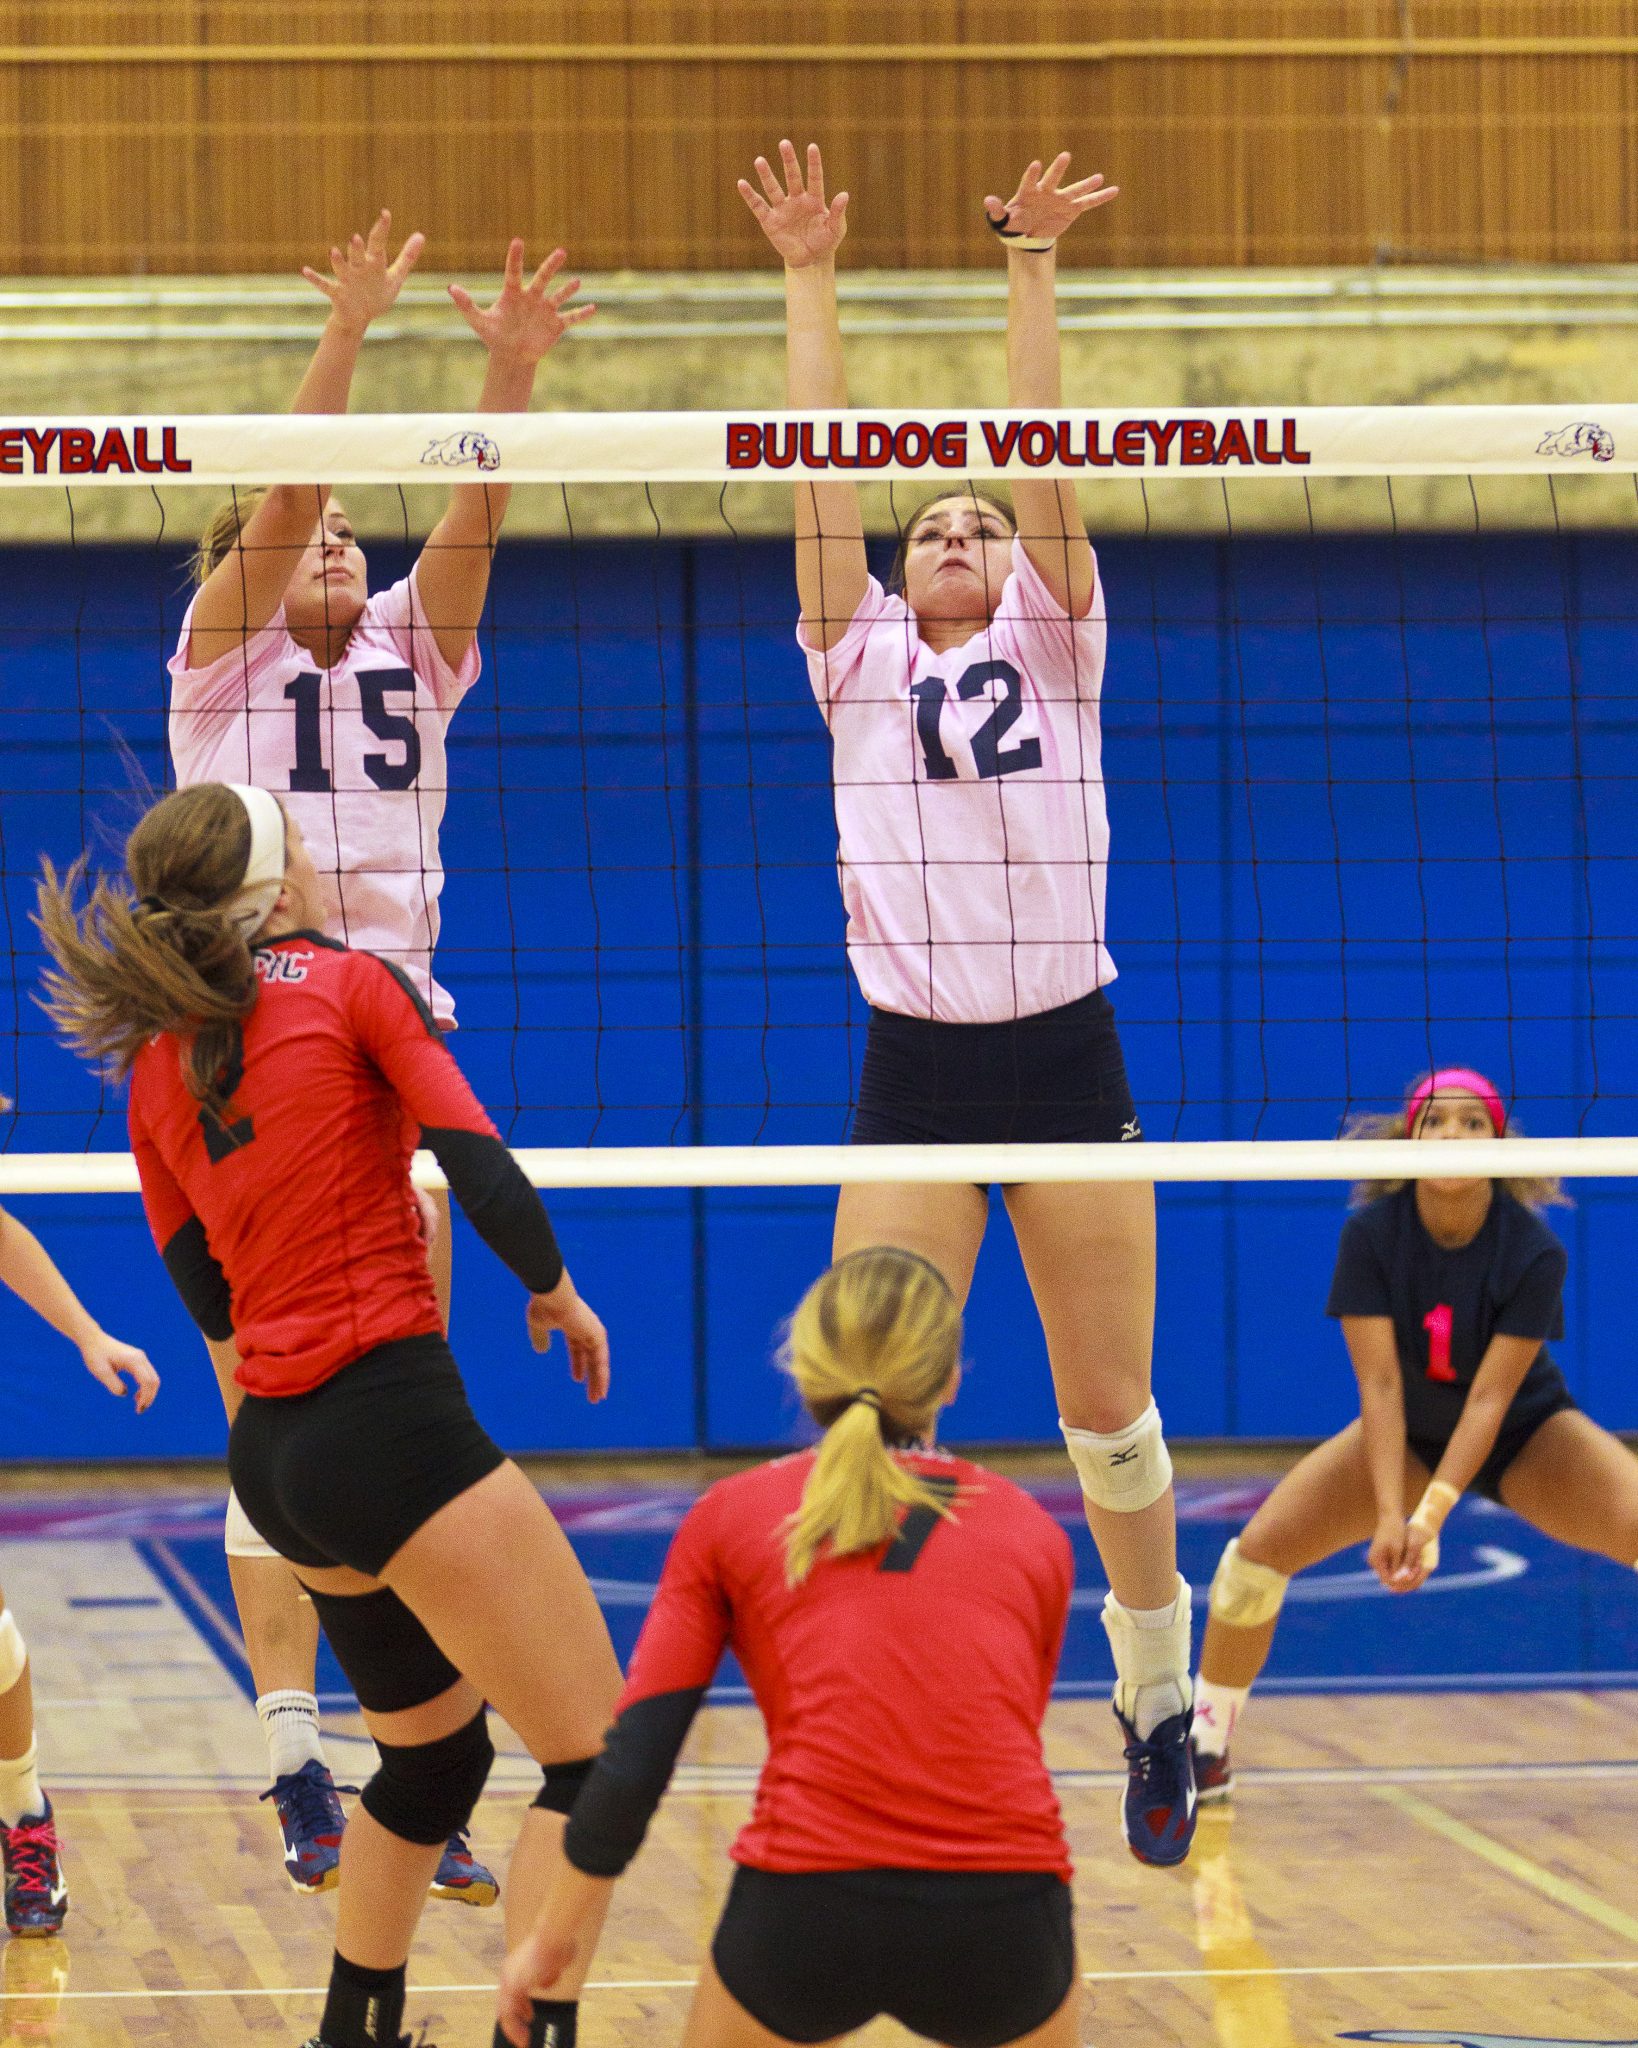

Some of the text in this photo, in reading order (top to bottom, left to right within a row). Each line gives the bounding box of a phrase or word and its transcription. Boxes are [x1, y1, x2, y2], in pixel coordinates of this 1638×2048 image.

[726, 418, 1310, 469] BULLDOG VOLLEYBALL
[284, 668, 421, 792] 15
[910, 660, 1042, 779] 12
[1423, 1303, 1456, 1382] 1
